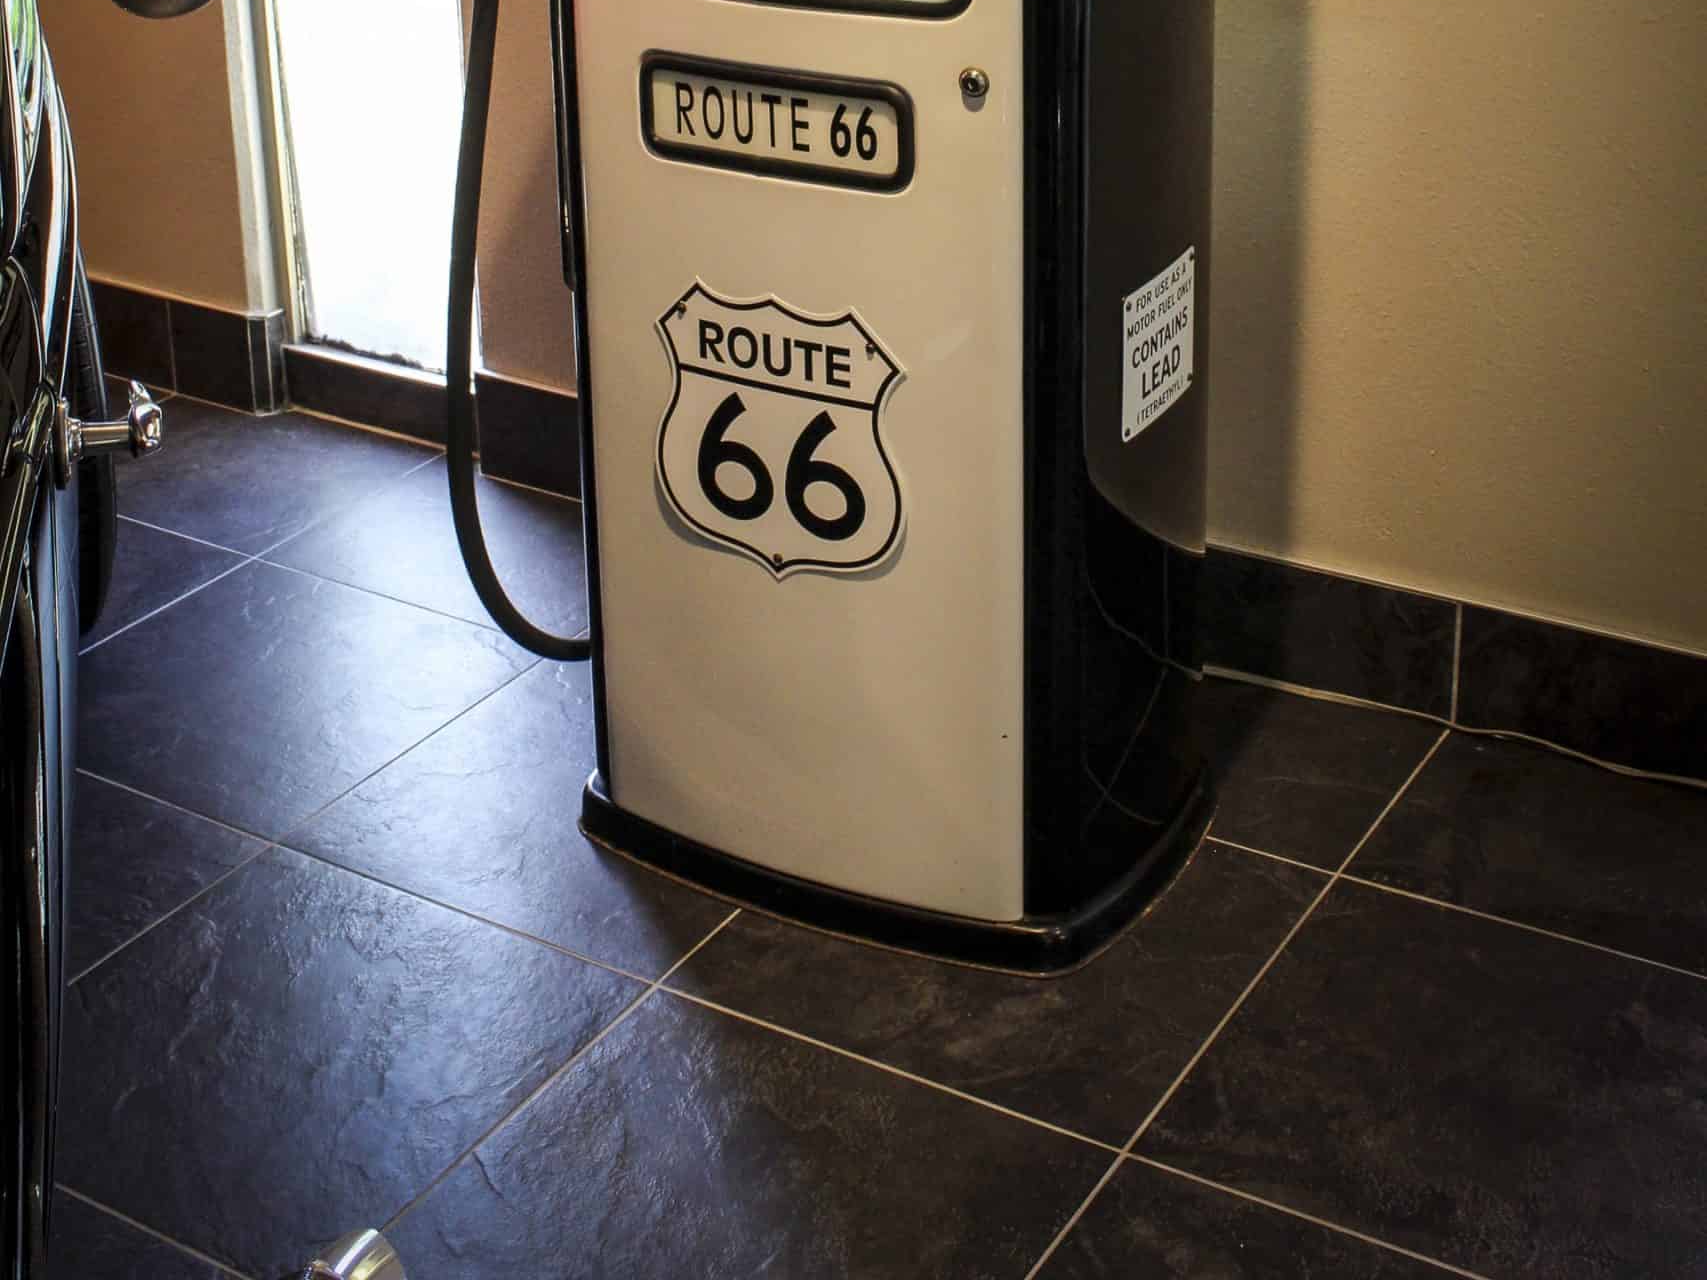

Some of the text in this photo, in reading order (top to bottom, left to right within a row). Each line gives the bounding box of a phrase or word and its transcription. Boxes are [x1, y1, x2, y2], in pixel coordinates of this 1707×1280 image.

[674, 81, 878, 161] ROUTE 66
[1127, 279, 1193, 341] MOTOR FUEL ONLY
[1135, 291, 1151, 313] FOR
[1155, 279, 1169, 300] USE
[1171, 267, 1181, 284] AS
[698, 318, 851, 389] ROUTE
[1132, 306, 1188, 369] CONTAINS
[1141, 344, 1181, 400] LEAD
[698, 391, 866, 541] 66
